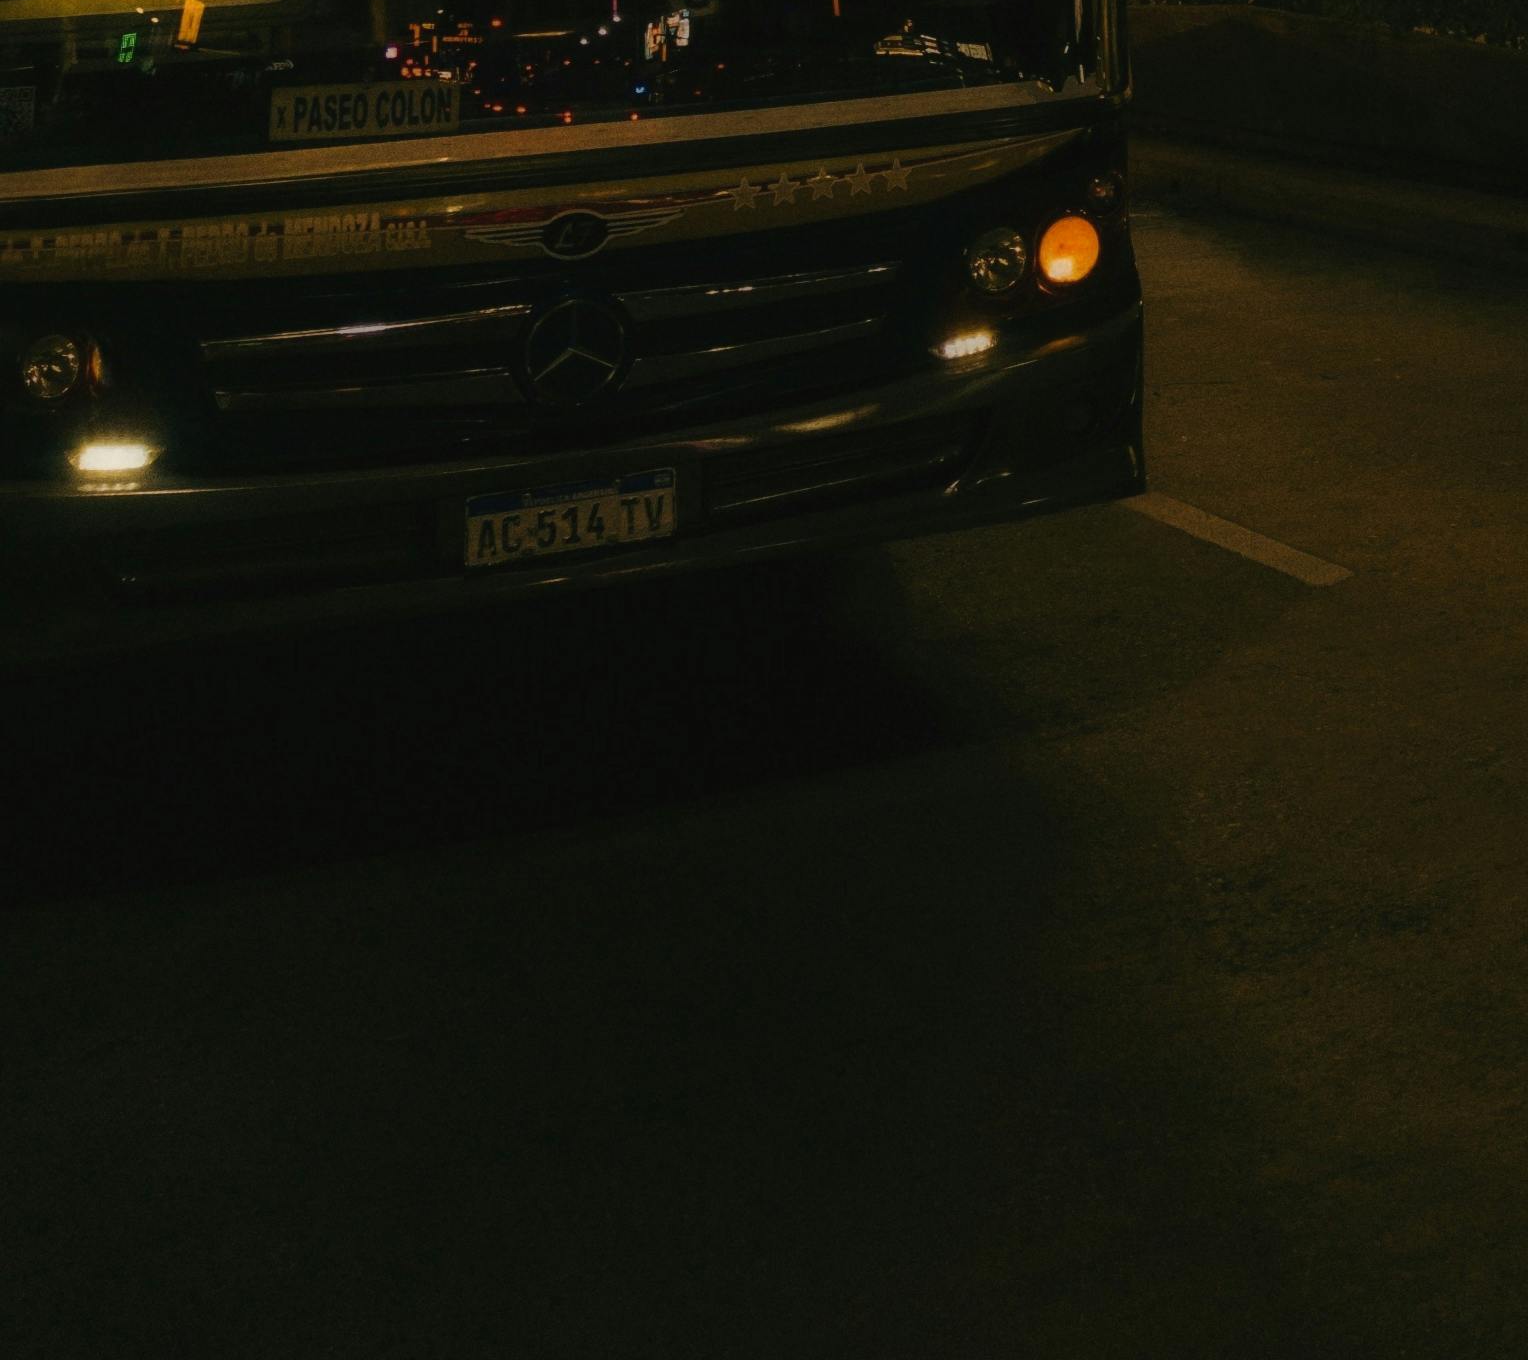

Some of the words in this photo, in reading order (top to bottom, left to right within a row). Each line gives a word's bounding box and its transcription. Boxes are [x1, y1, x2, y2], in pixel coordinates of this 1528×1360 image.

[293, 93, 369, 133] PASEO
[376, 87, 451, 129] COLON
[478, 514, 521, 558] AC
[537, 503, 605, 547] 514
[620, 495, 664, 535] TV
